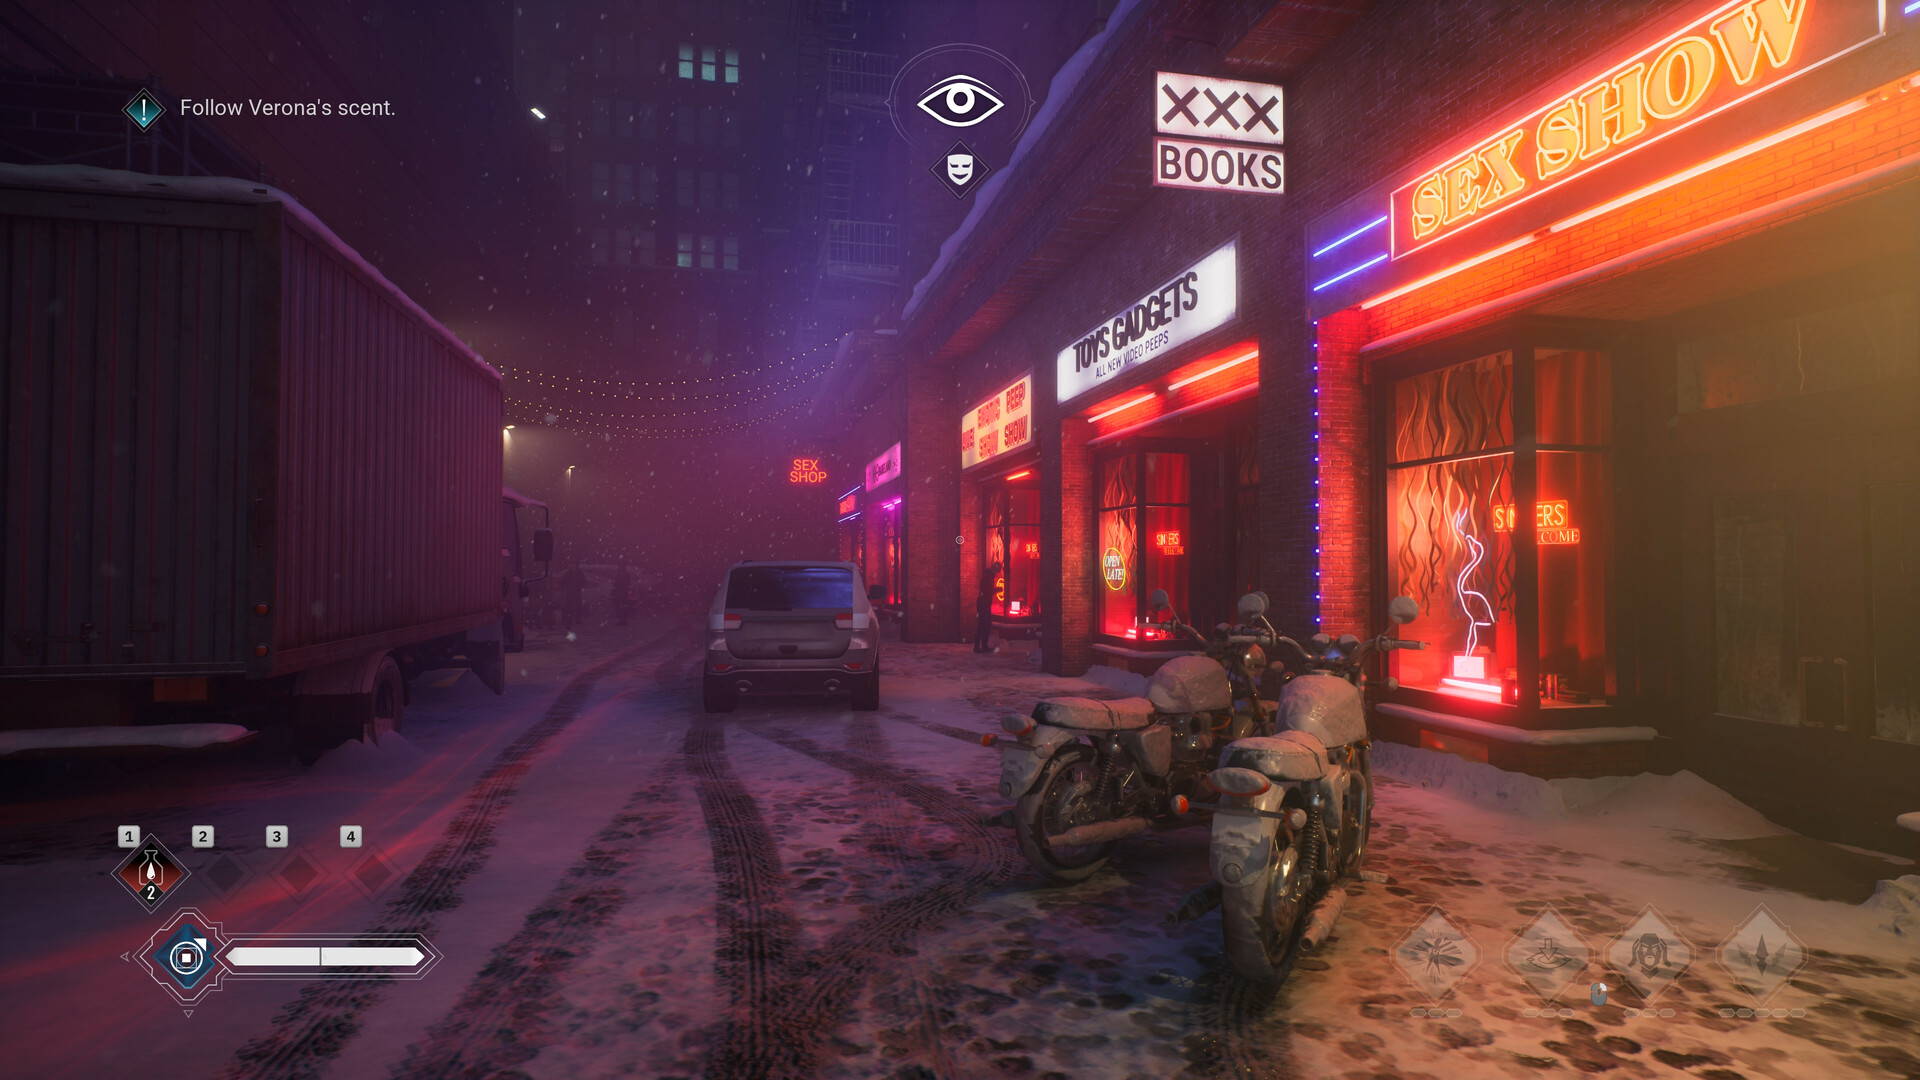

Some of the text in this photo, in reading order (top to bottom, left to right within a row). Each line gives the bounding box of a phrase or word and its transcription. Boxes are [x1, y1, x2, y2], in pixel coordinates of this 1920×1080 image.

[1161, 83, 1280, 136] XXX
[1412, 0, 1805, 240] SEX SHOW
[1160, 144, 1282, 190] BOOKS
[1072, 271, 1199, 373] TOYS GADGETS
[1095, 330, 1170, 380] ALL NEW VIDEO PEEPS
[1005, 380, 1026, 415] PEEP
[1004, 413, 1028, 449] SHOW
[789, 470, 828, 483] SHOP
[793, 458, 819, 471] SEX
[1495, 503, 1566, 529] SERS
[1104, 555, 1120, 567] OPEN
[1106, 568, 1124, 580] LATE!
